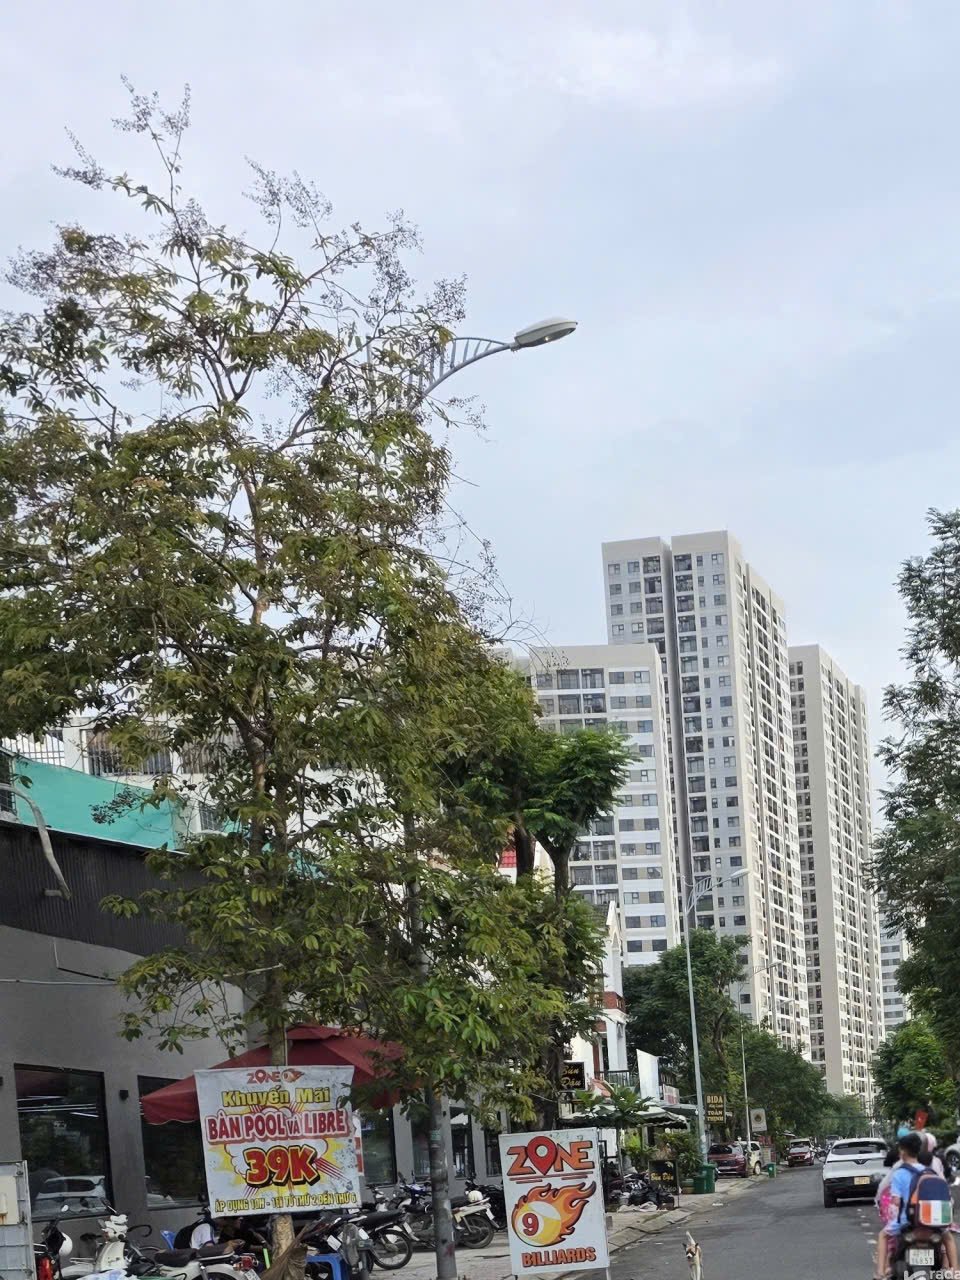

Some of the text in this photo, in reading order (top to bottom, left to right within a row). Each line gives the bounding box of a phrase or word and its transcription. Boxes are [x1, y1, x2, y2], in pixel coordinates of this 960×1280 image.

[247, 1069, 281, 1084] ZONE
[221, 1085, 331, 1107] Khuyến Mãi
[706, 1095, 723, 1104] BIDA
[206, 1109, 347, 1141] BÀN POOL VÀ LIBRE
[243, 1144, 321, 1188] 39K
[506, 1135, 595, 1176] ZONE
[521, 1212, 540, 1237] 9
[521, 1246, 597, 1268] BILLIARDS
